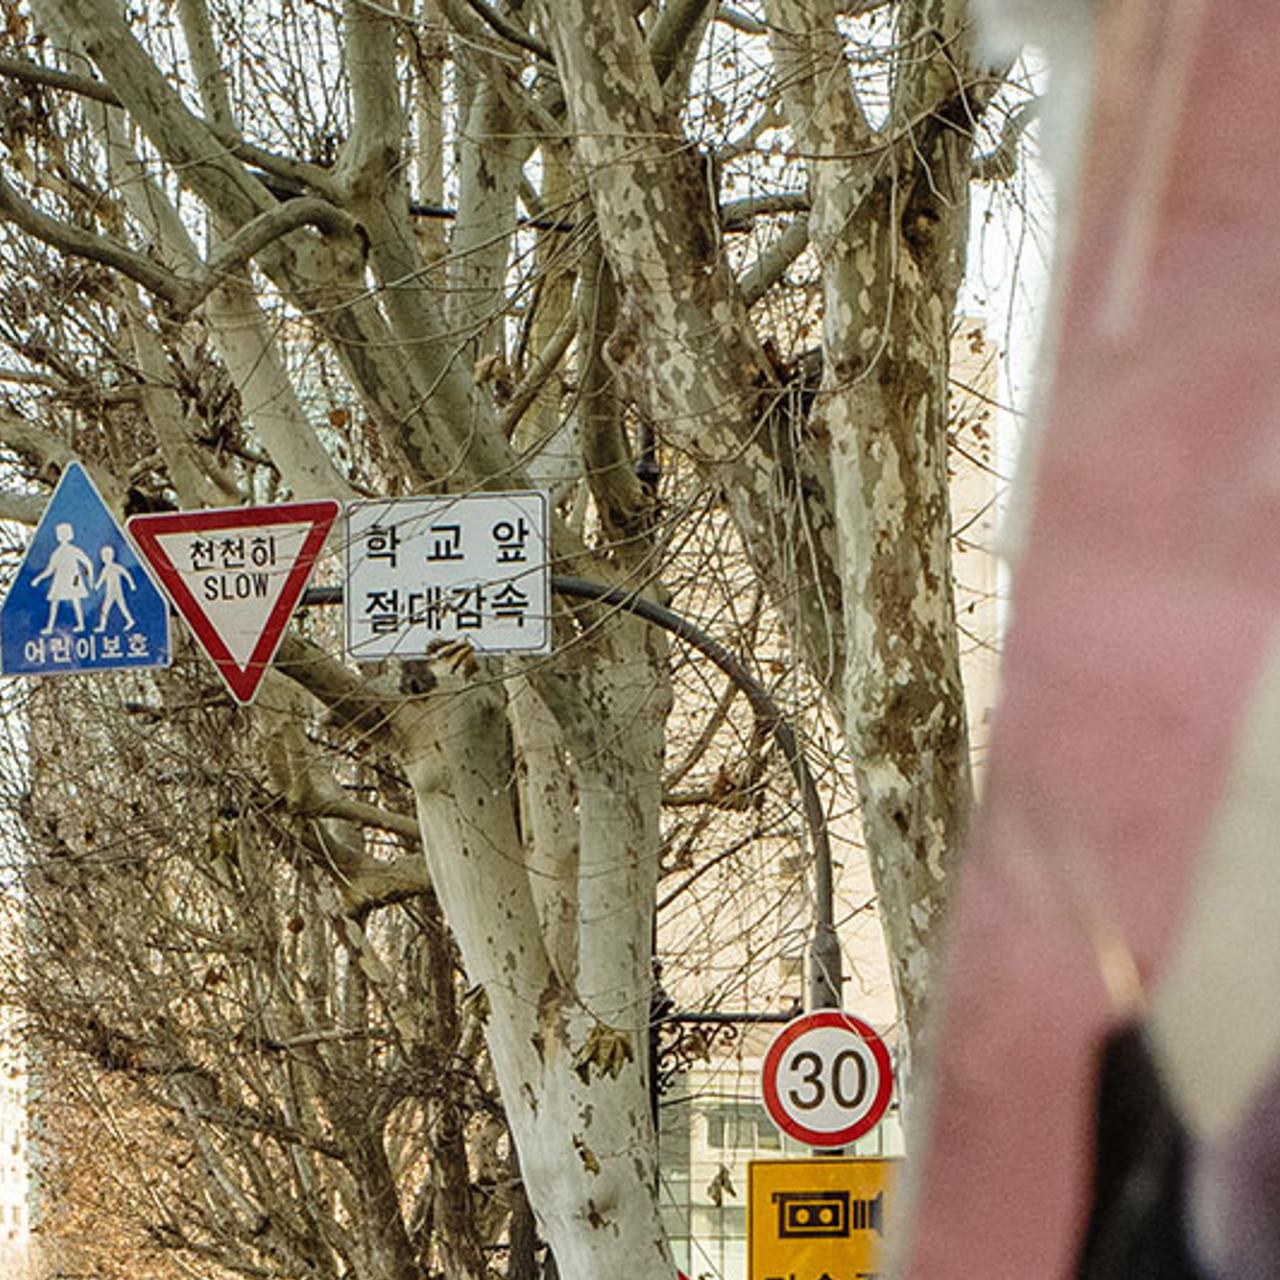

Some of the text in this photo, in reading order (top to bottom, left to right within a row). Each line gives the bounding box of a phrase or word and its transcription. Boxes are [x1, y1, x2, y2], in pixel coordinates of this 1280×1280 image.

[189, 536, 277, 572] 천천히
[203, 573, 270, 601] SLOW
[363, 577, 530, 632] 절대감속
[23, 634, 151, 665] 어린이보호
[787, 1050, 868, 1111] 30
